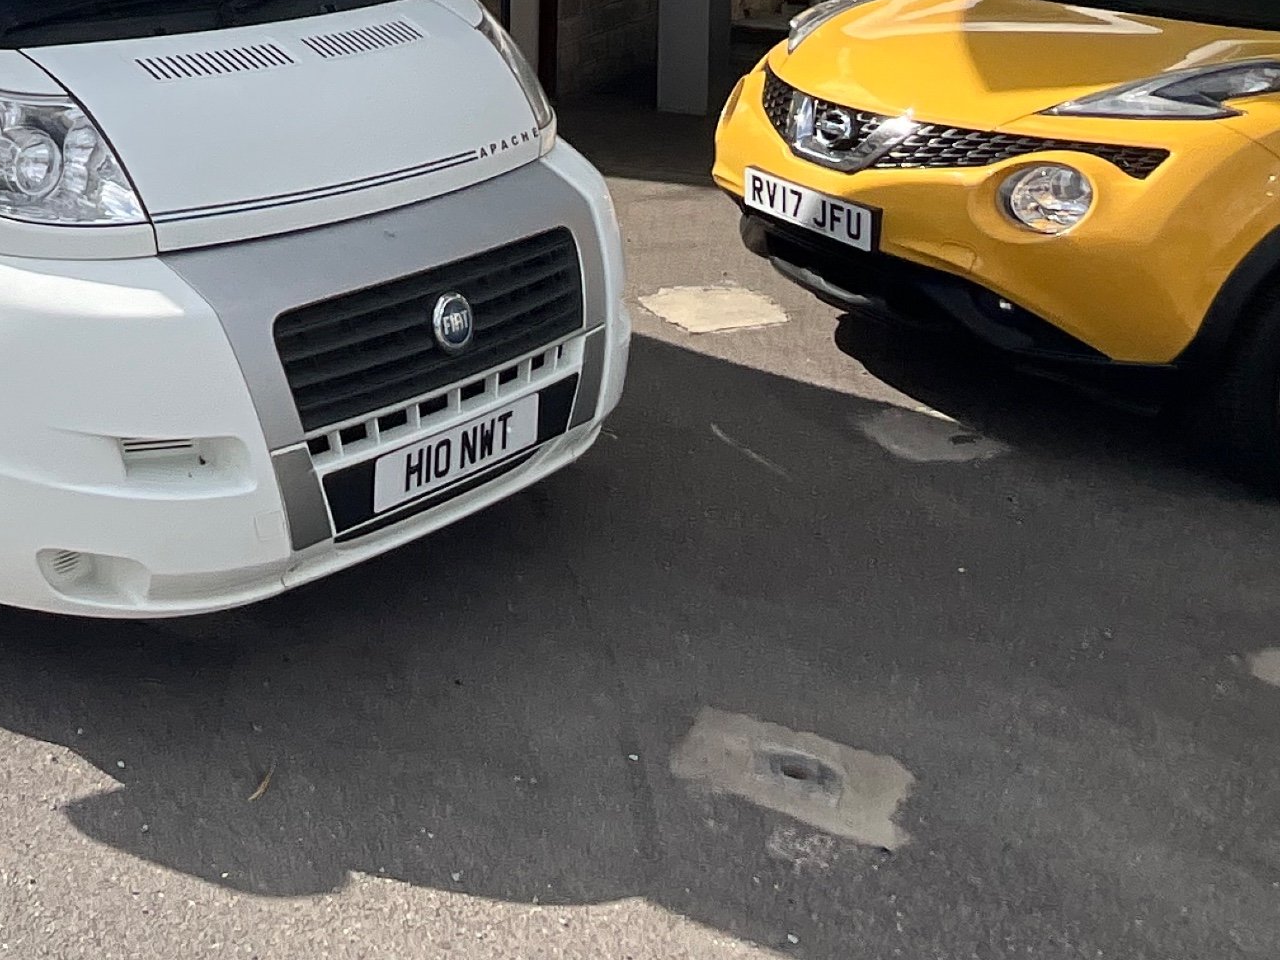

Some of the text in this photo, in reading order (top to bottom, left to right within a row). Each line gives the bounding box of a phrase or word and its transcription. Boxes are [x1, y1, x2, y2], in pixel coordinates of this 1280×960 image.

[479, 126, 539, 159] APACHE
[751, 174, 861, 241] RV17 JFU
[442, 309, 469, 336] FIAT
[459, 410, 514, 470] NWT
